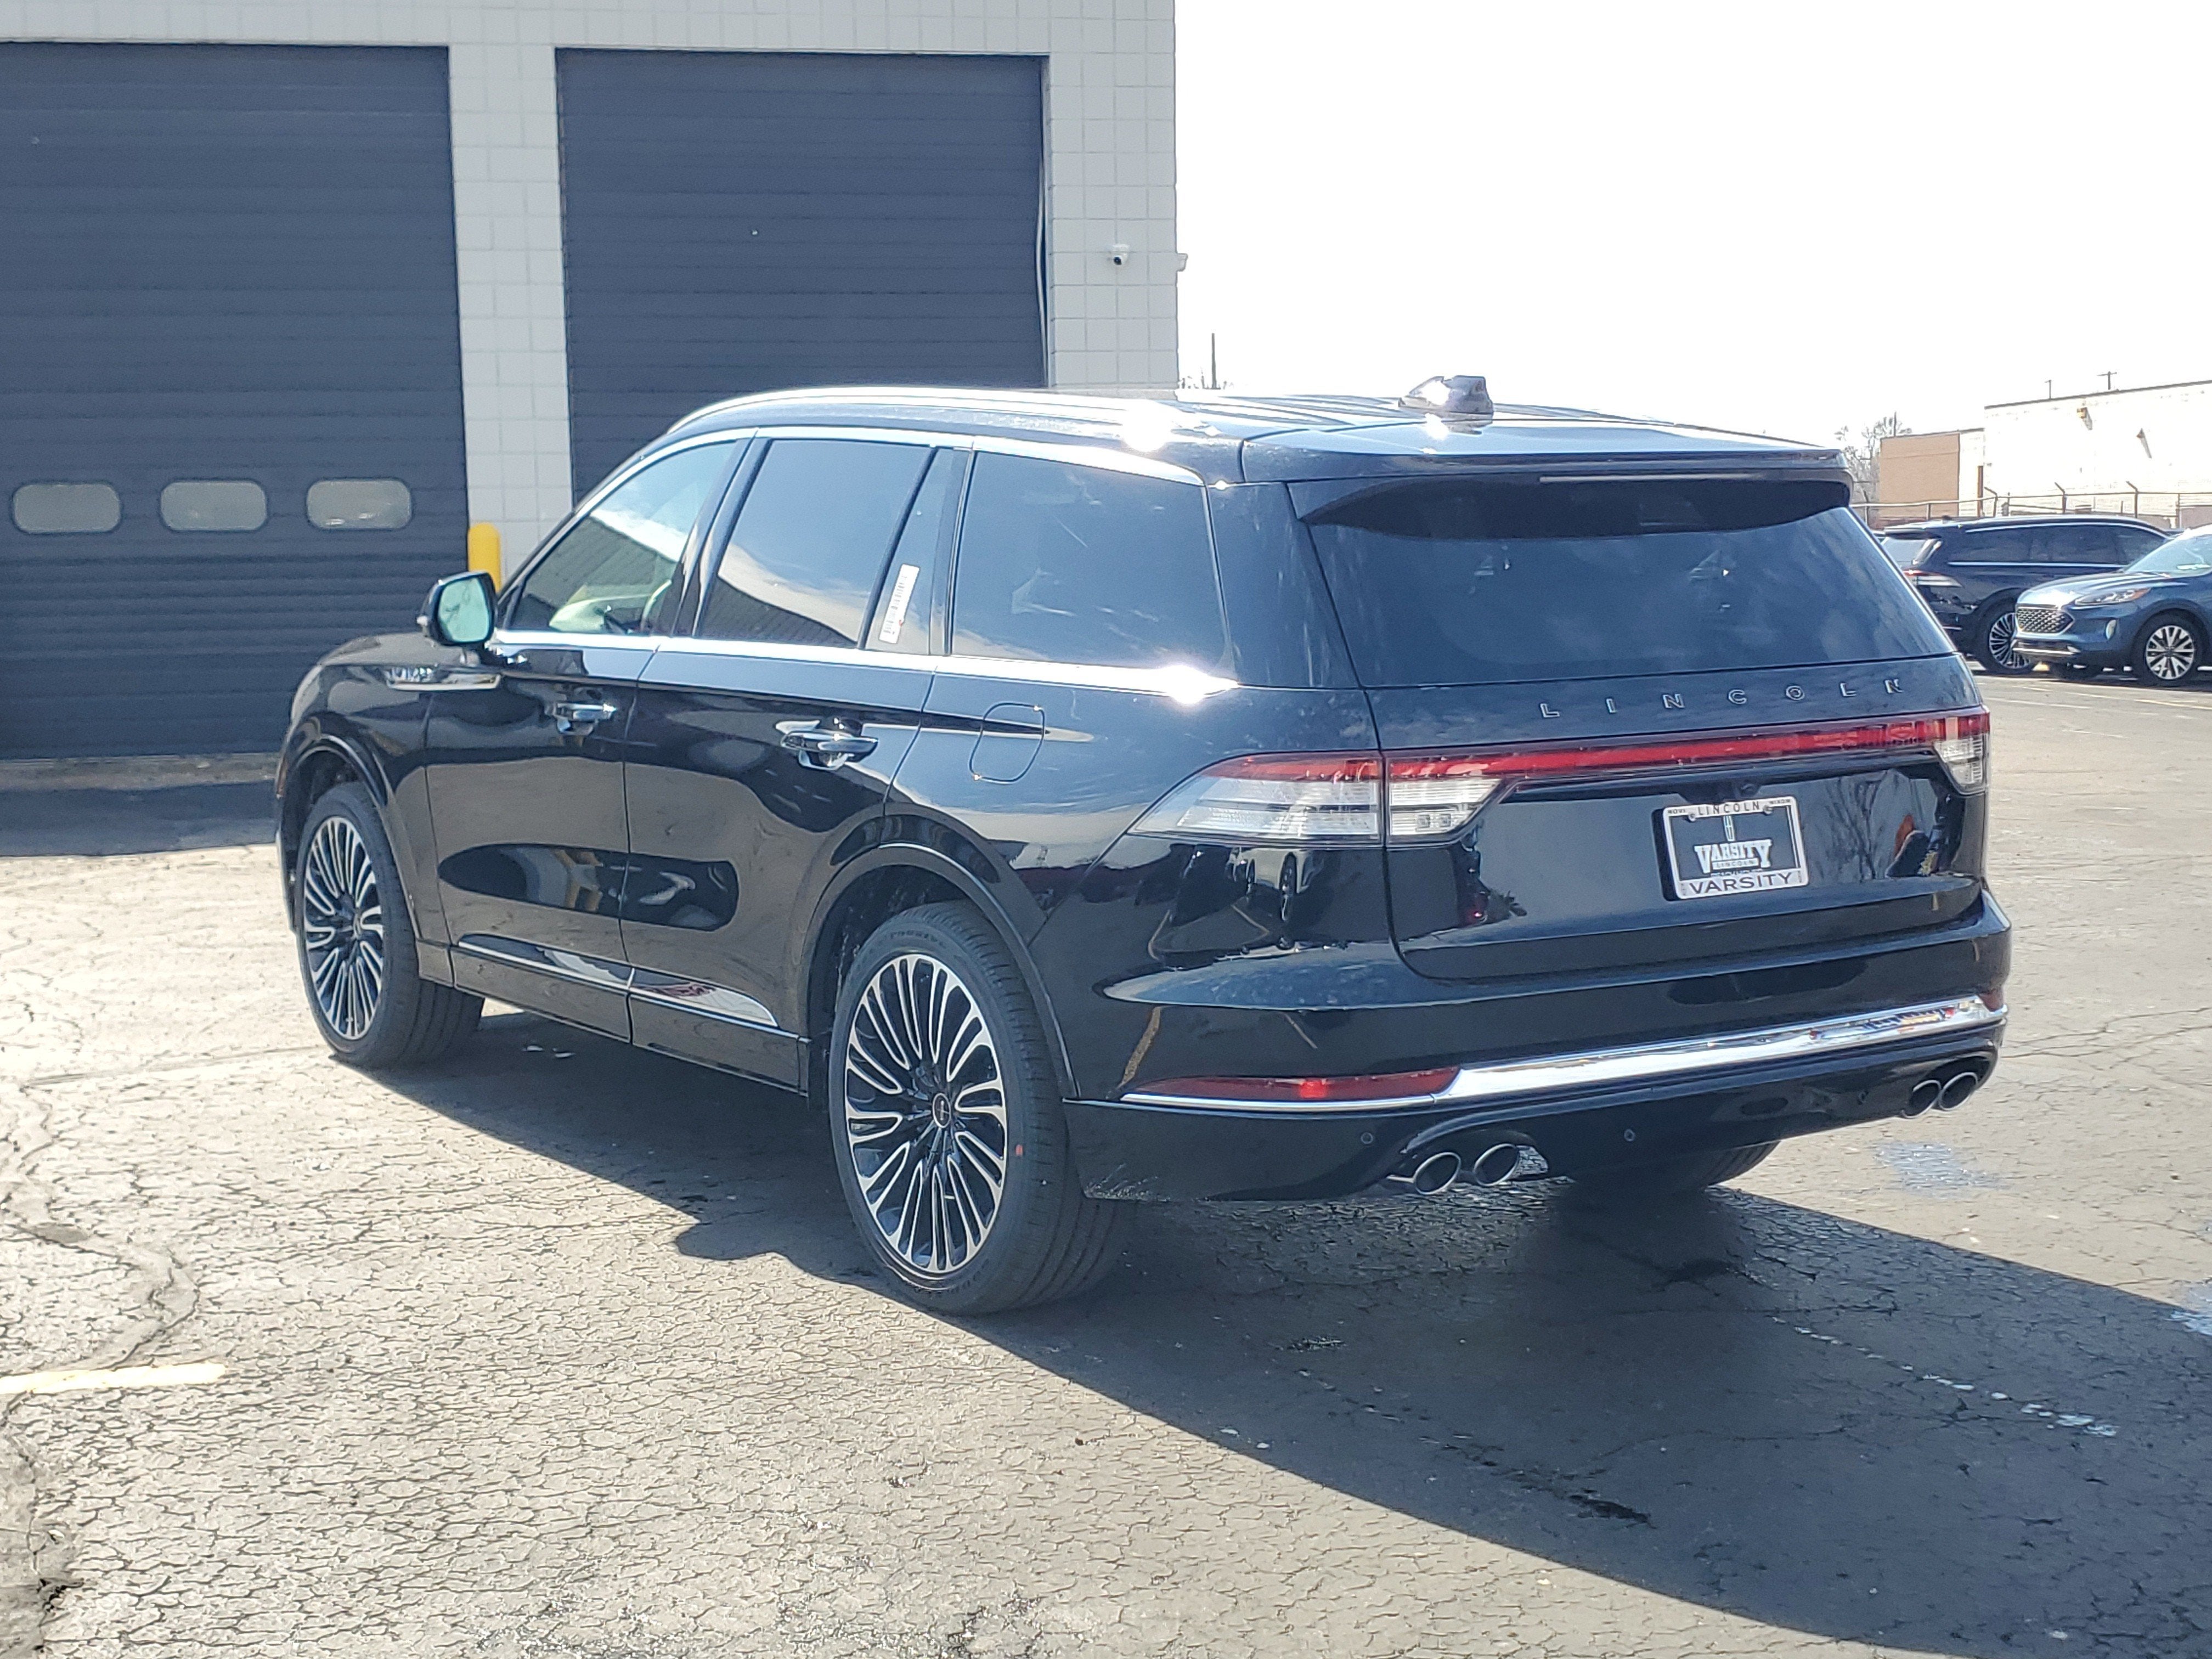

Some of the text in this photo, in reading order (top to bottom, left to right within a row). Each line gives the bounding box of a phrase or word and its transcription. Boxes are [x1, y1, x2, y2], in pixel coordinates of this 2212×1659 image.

[1539, 678, 1903, 719] LINCOLN
[1698, 802, 1760, 815] LINCOLN
[1694, 839, 1773, 874] VARSITY
[1716, 860, 1755, 868] LINCOLN
[1689, 872, 1792, 894] VARSITY
